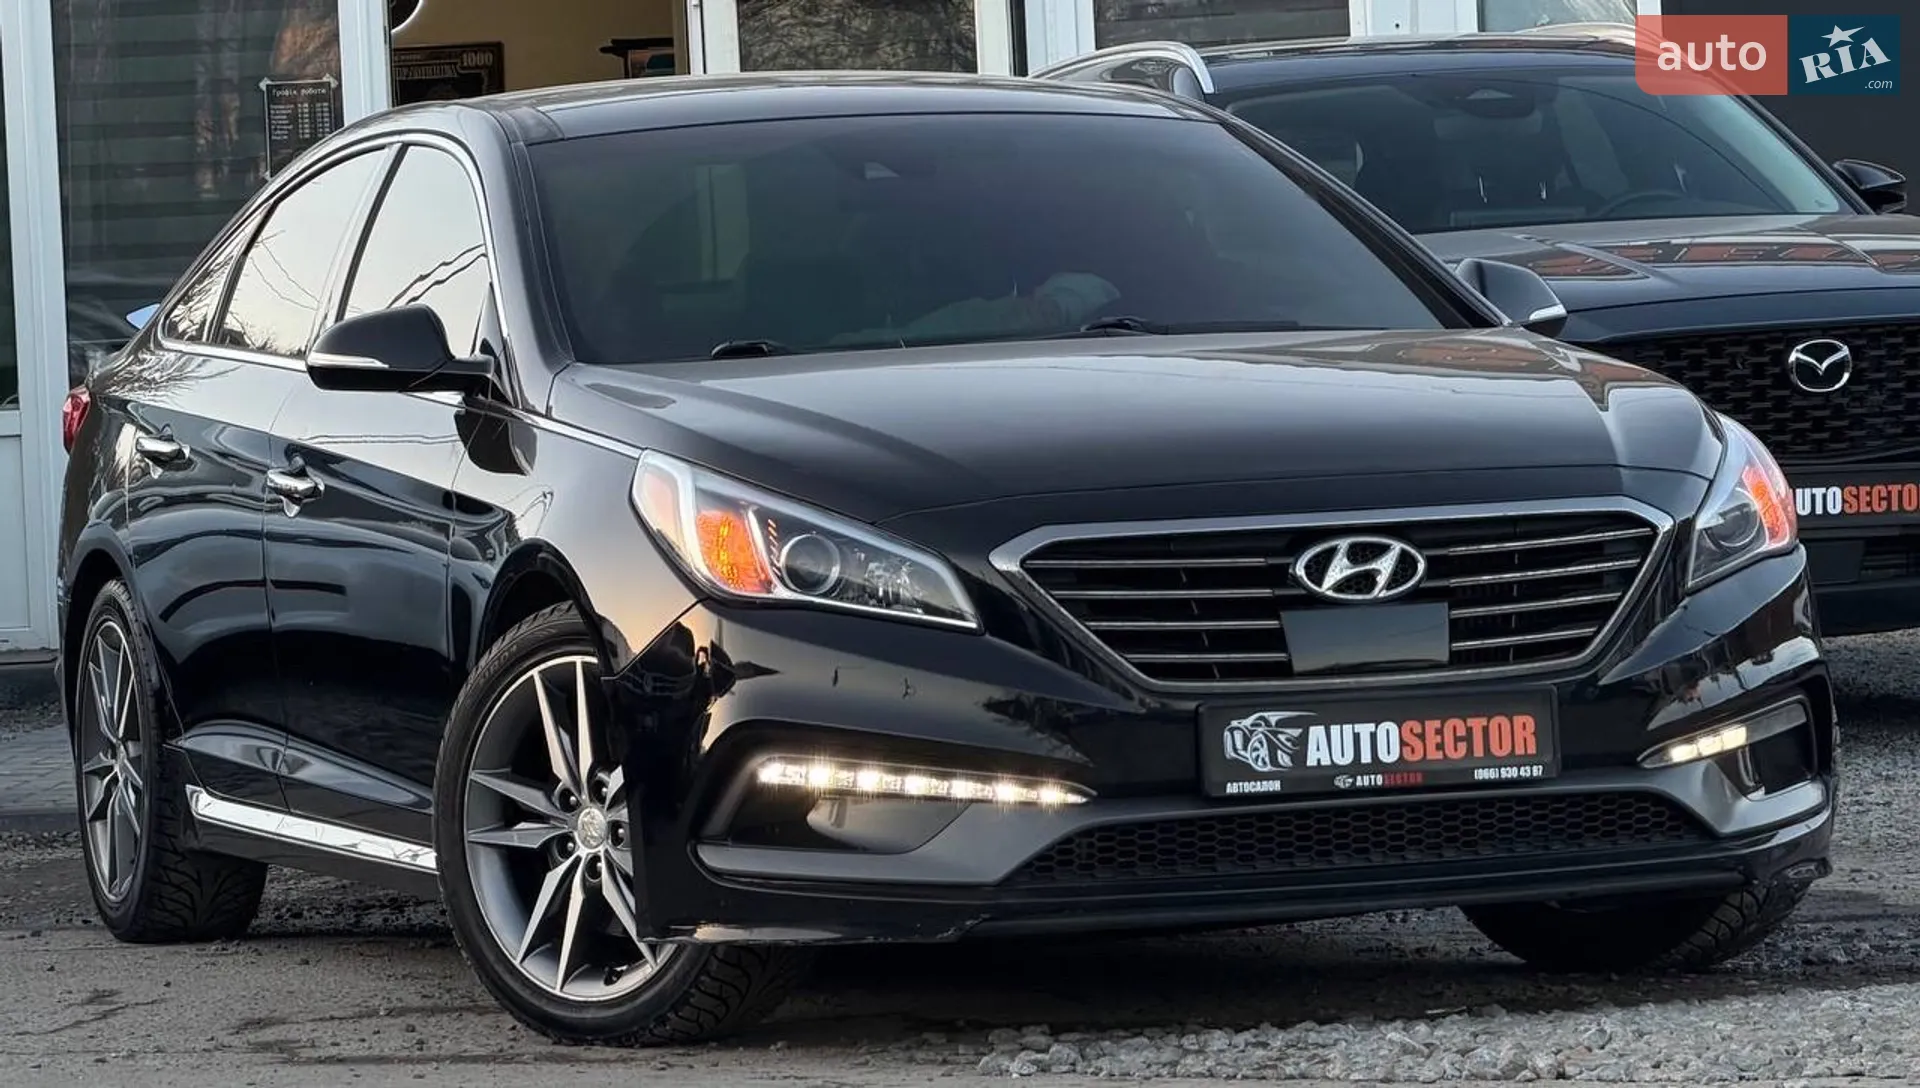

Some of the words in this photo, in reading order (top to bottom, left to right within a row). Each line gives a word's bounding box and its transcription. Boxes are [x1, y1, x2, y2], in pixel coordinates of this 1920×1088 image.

[462, 52, 493, 67] 1000
[1794, 483, 1920, 516] UTOSECTO
[1306, 715, 1537, 766] AUTOSECTOR
